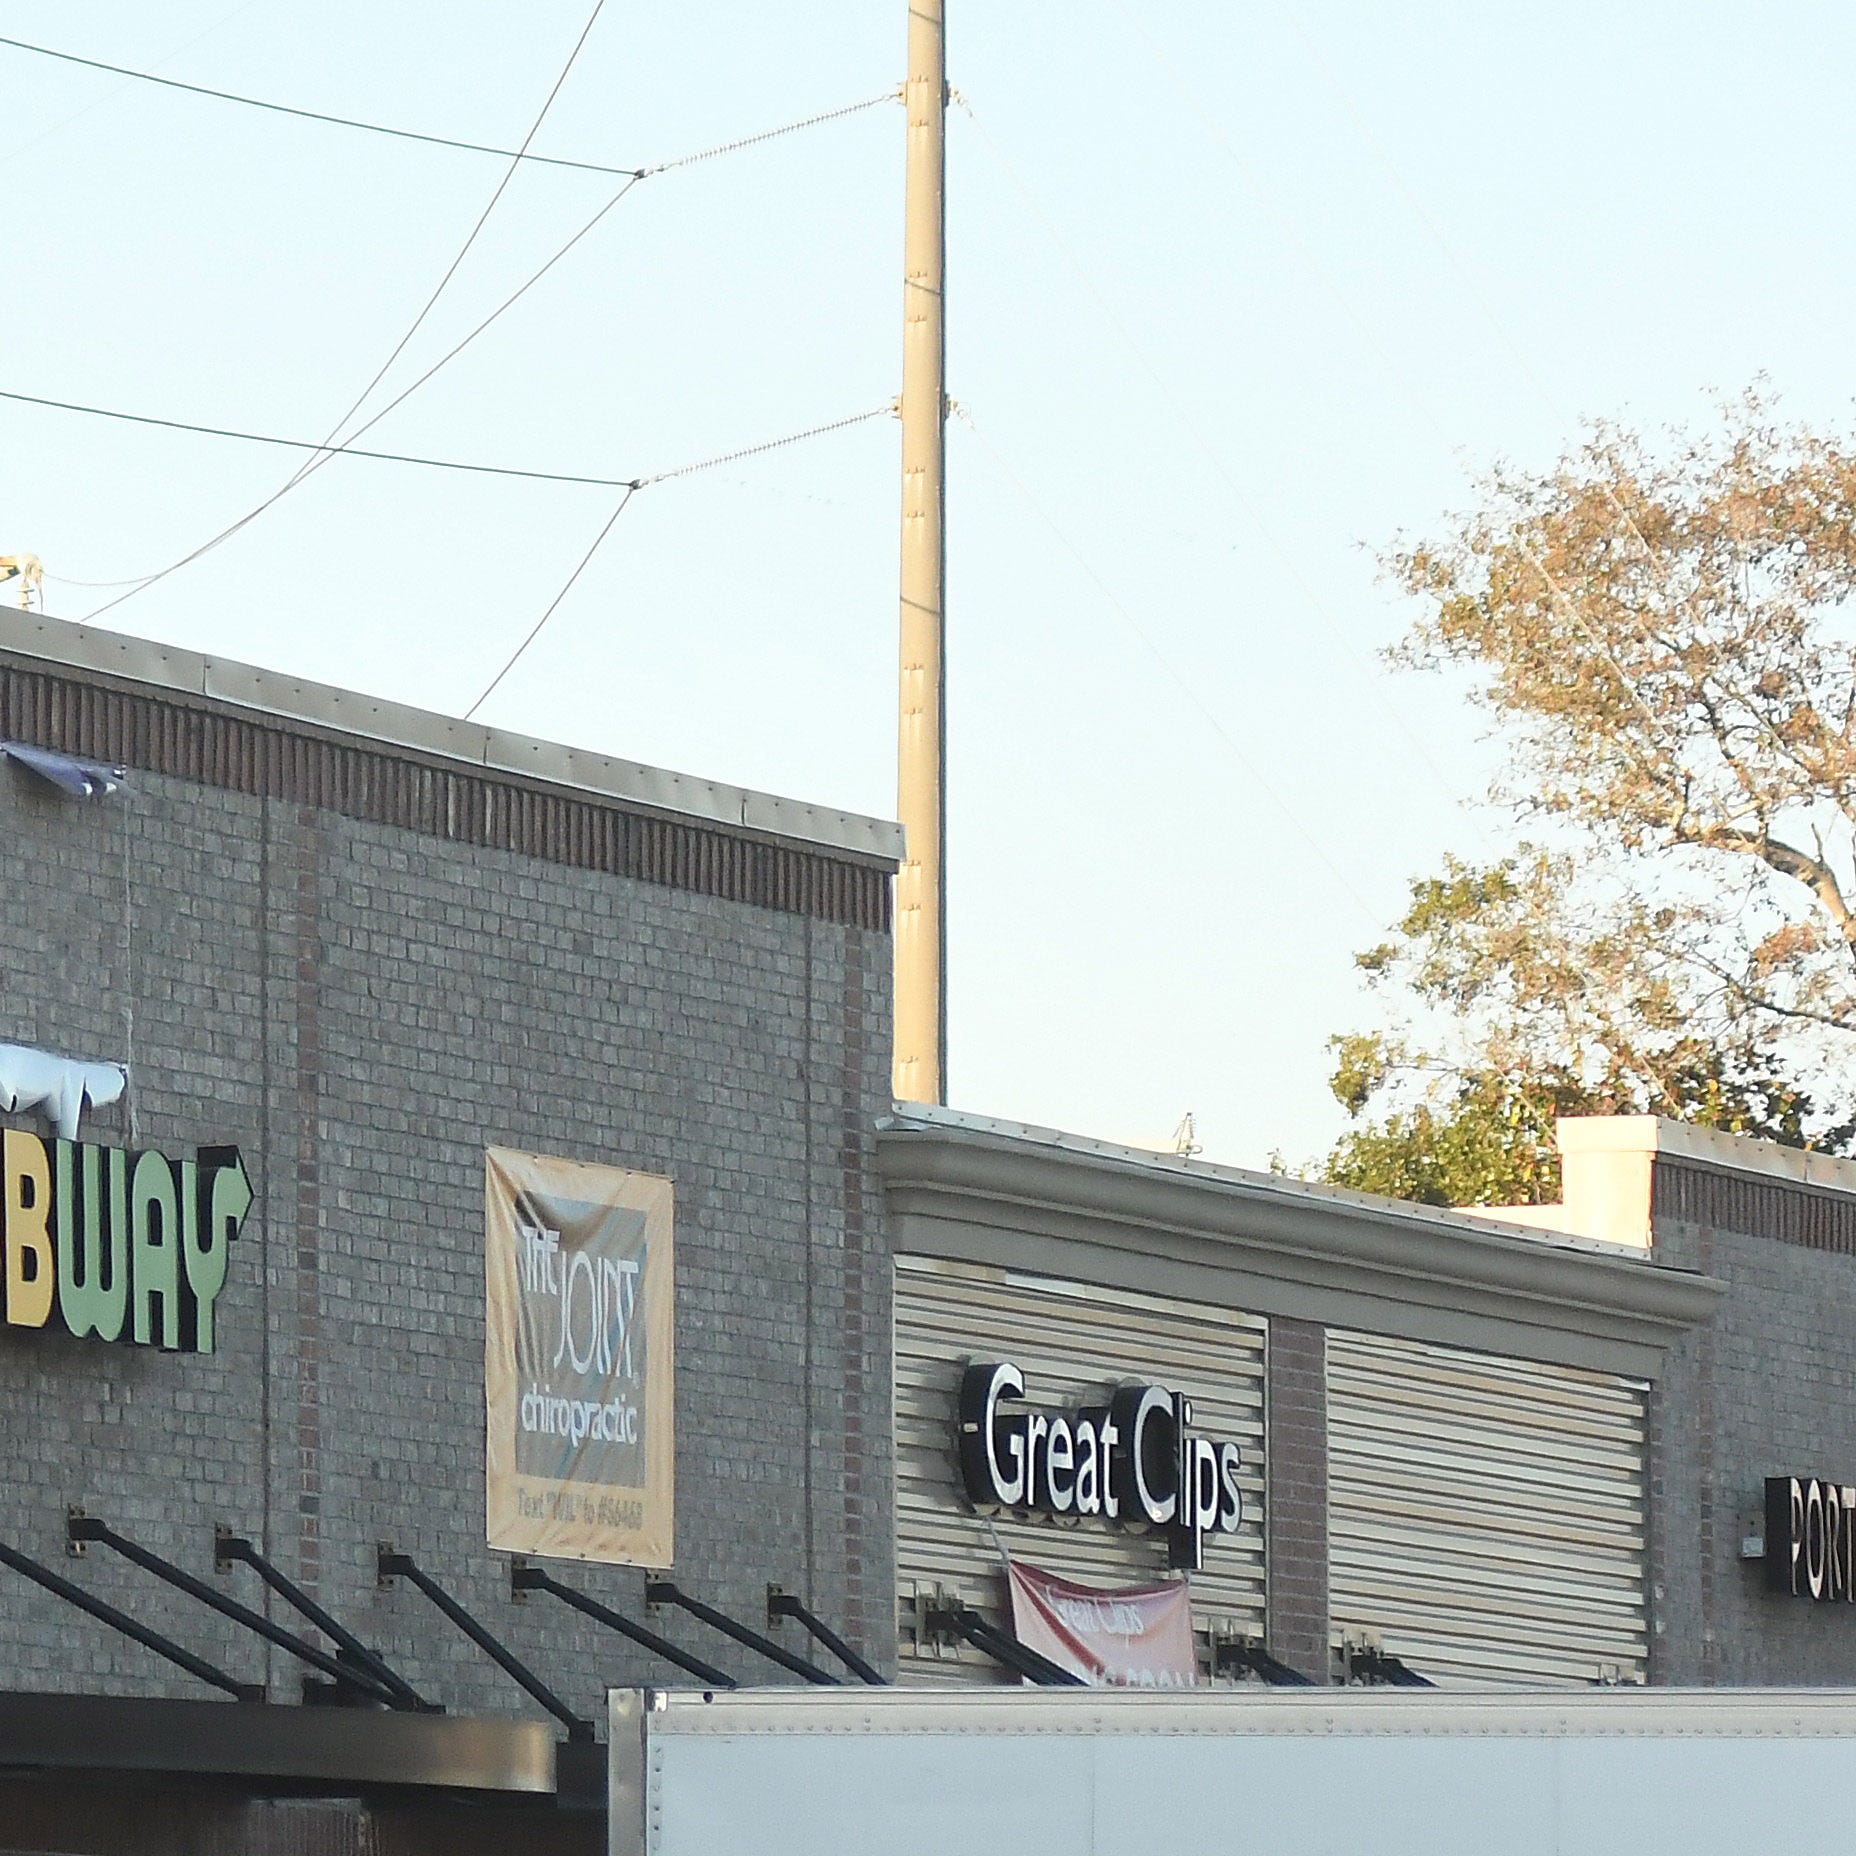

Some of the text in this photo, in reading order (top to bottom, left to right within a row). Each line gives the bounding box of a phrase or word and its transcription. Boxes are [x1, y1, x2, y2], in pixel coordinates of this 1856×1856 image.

[522, 1226, 561, 1295] THE
[553, 1250, 640, 1379] JOINT
[521, 1384, 639, 1448] chiropractic
[986, 1362, 1243, 1570] Great Clips
[1790, 1477, 1855, 1603] PORT
